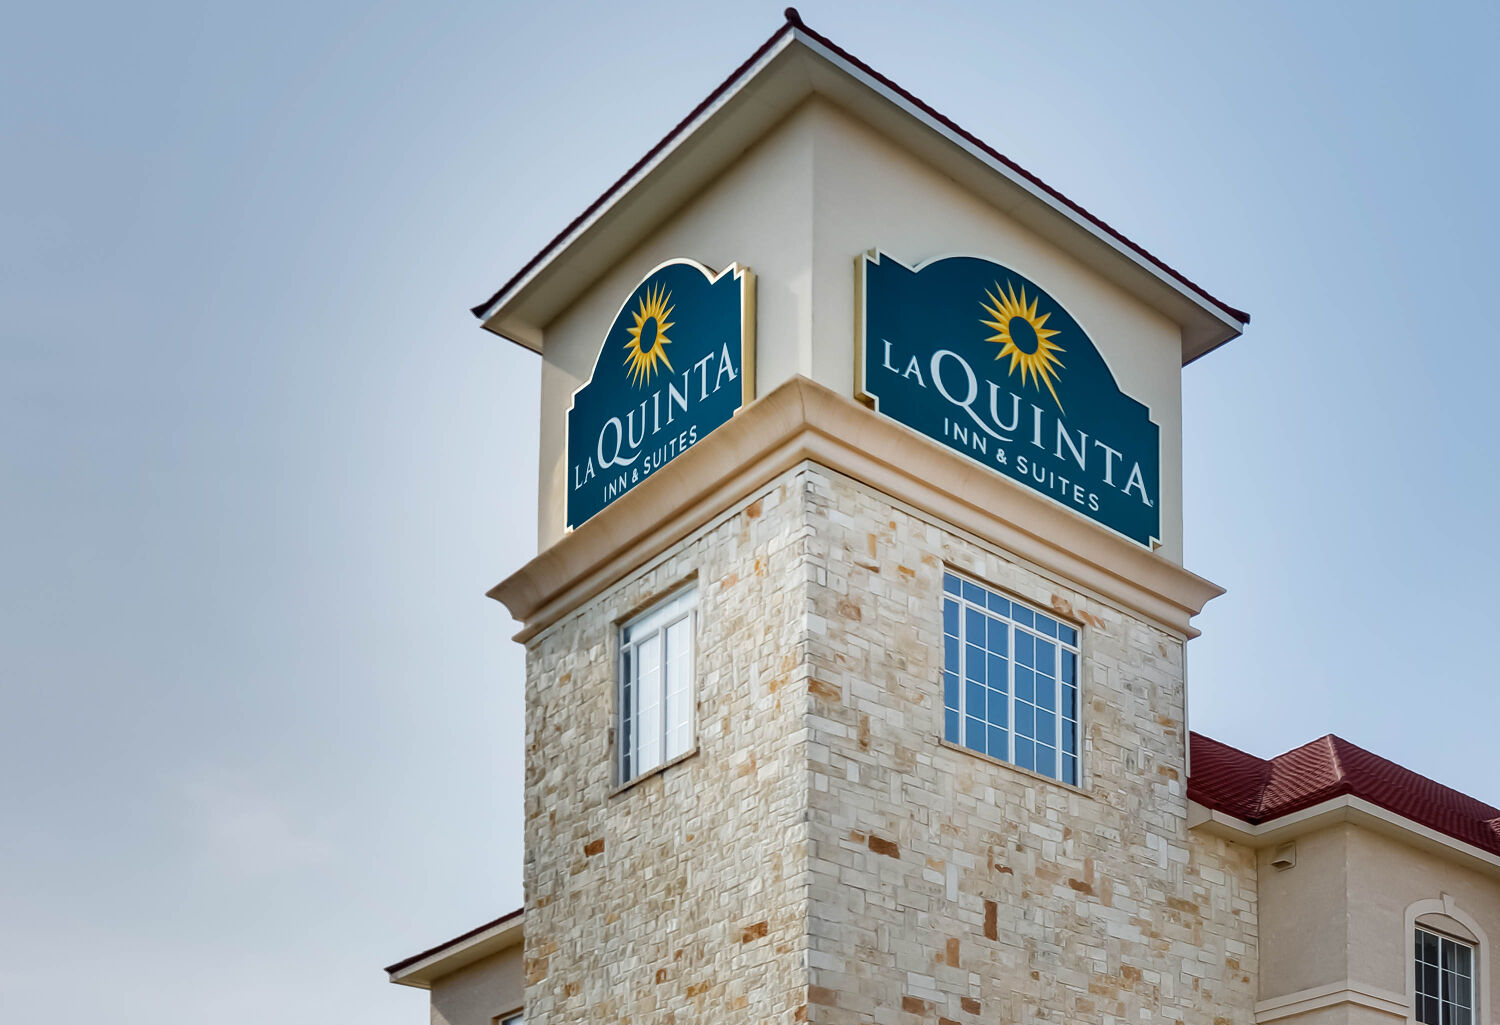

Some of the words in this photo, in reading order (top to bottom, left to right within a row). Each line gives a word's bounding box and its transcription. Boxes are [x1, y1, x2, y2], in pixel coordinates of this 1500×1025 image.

[574, 455, 596, 491] LA
[597, 341, 738, 470] QUINTA
[603, 471, 627, 502] INN
[631, 467, 639, 483] &
[643, 424, 698, 476] SUITES
[881, 338, 927, 388] LA
[930, 349, 1153, 508] QUINTA
[944, 417, 987, 455] INN
[996, 447, 1008, 465] &
[1016, 455, 1099, 512] SUITES
